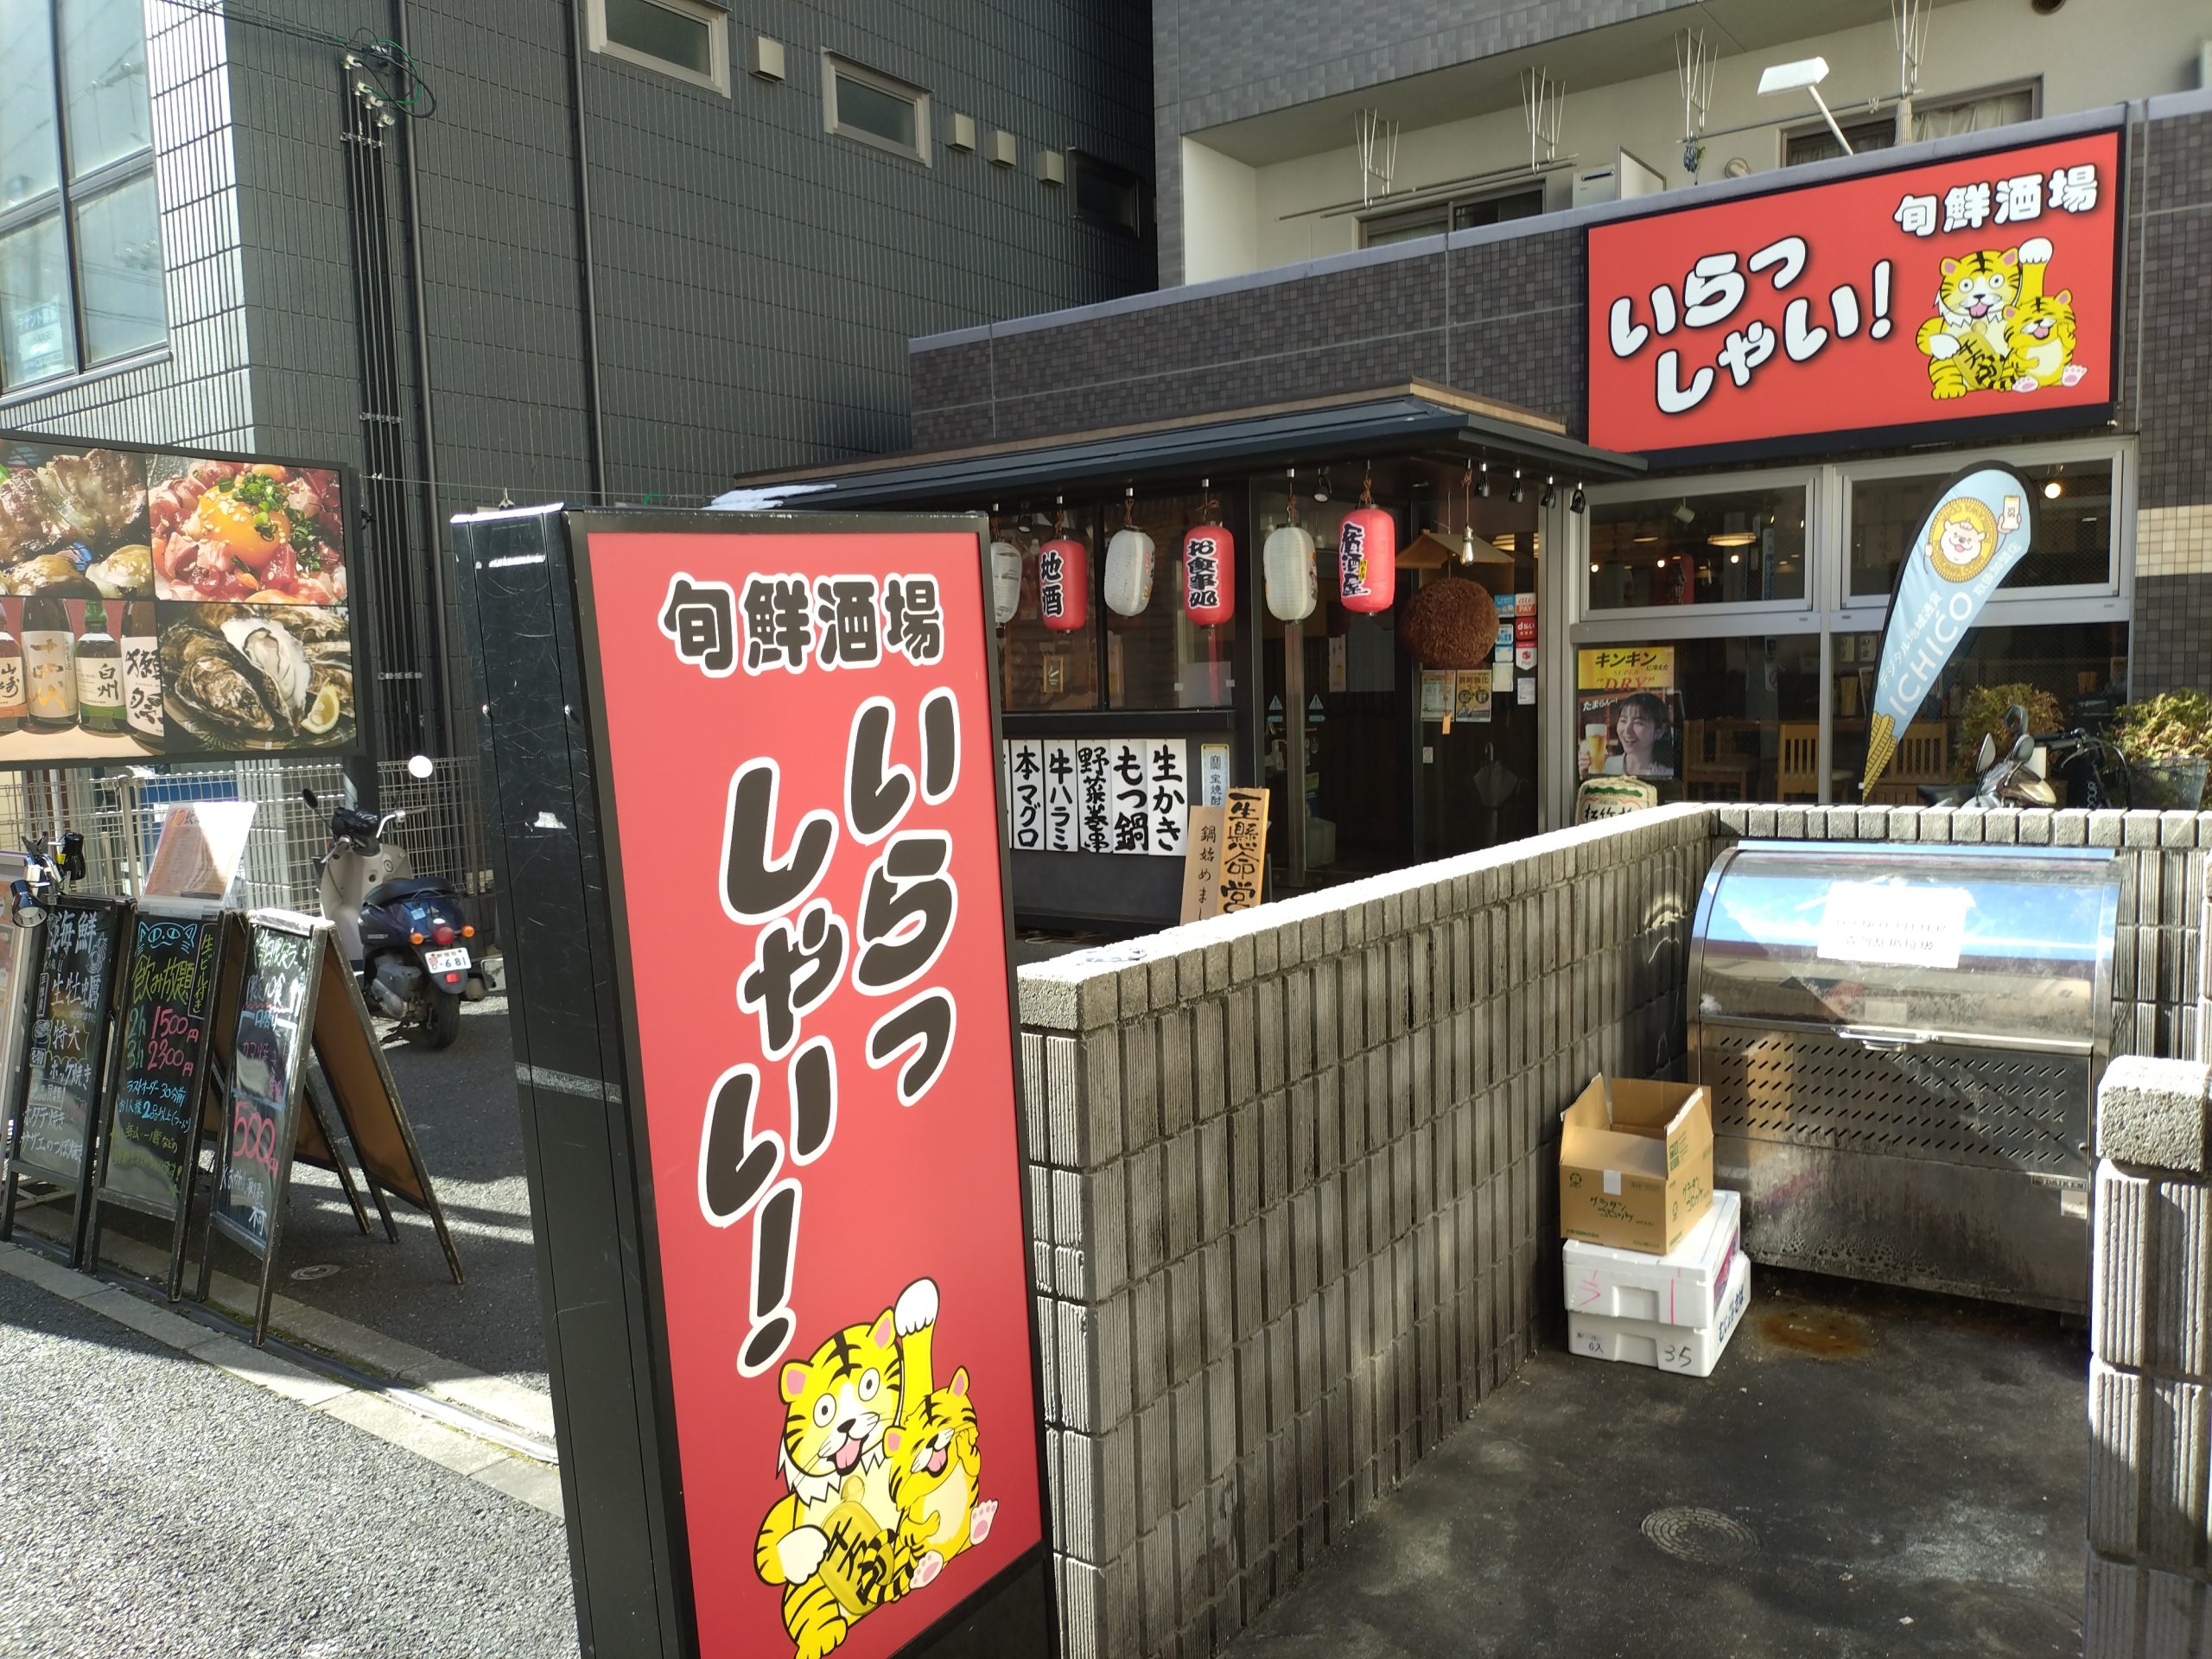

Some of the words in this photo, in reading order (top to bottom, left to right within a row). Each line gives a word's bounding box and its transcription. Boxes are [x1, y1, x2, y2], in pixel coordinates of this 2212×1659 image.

[1892, 163, 2099, 238] 旬鮮酒場
[1039, 550, 1064, 617] 地酒
[1186, 538, 1220, 608] お食事処
[1340, 522, 1370, 597] 居酒屋
[658, 571, 944, 677] 旬鮮酒場
[1890, 592, 1973, 715] ICHICO
[97, 663, 119, 701] 白州
[1595, 652, 1657, 668] キンキン
[1014, 746, 1040, 848] 本マグロ
[1049, 748, 1073, 850] 牛ハラミ
[1113, 746, 1148, 851] もつ鍋
[1152, 744, 1185, 851] 生かき
[1210, 774, 1222, 805] 宝焼酎
[49, 910, 97, 955] 海鮮
[131, 955, 194, 1005] 飲み放題
[193, 934, 213, 1014] 生ビール付き
[53, 1020, 80, 1051] 特大
[147, 1039, 194, 1077] 2300円
[150, 1006, 199, 1043] 1500円
[232, 1102, 279, 1179] 500円
[1664, 1344, 1692, 1368] 35
